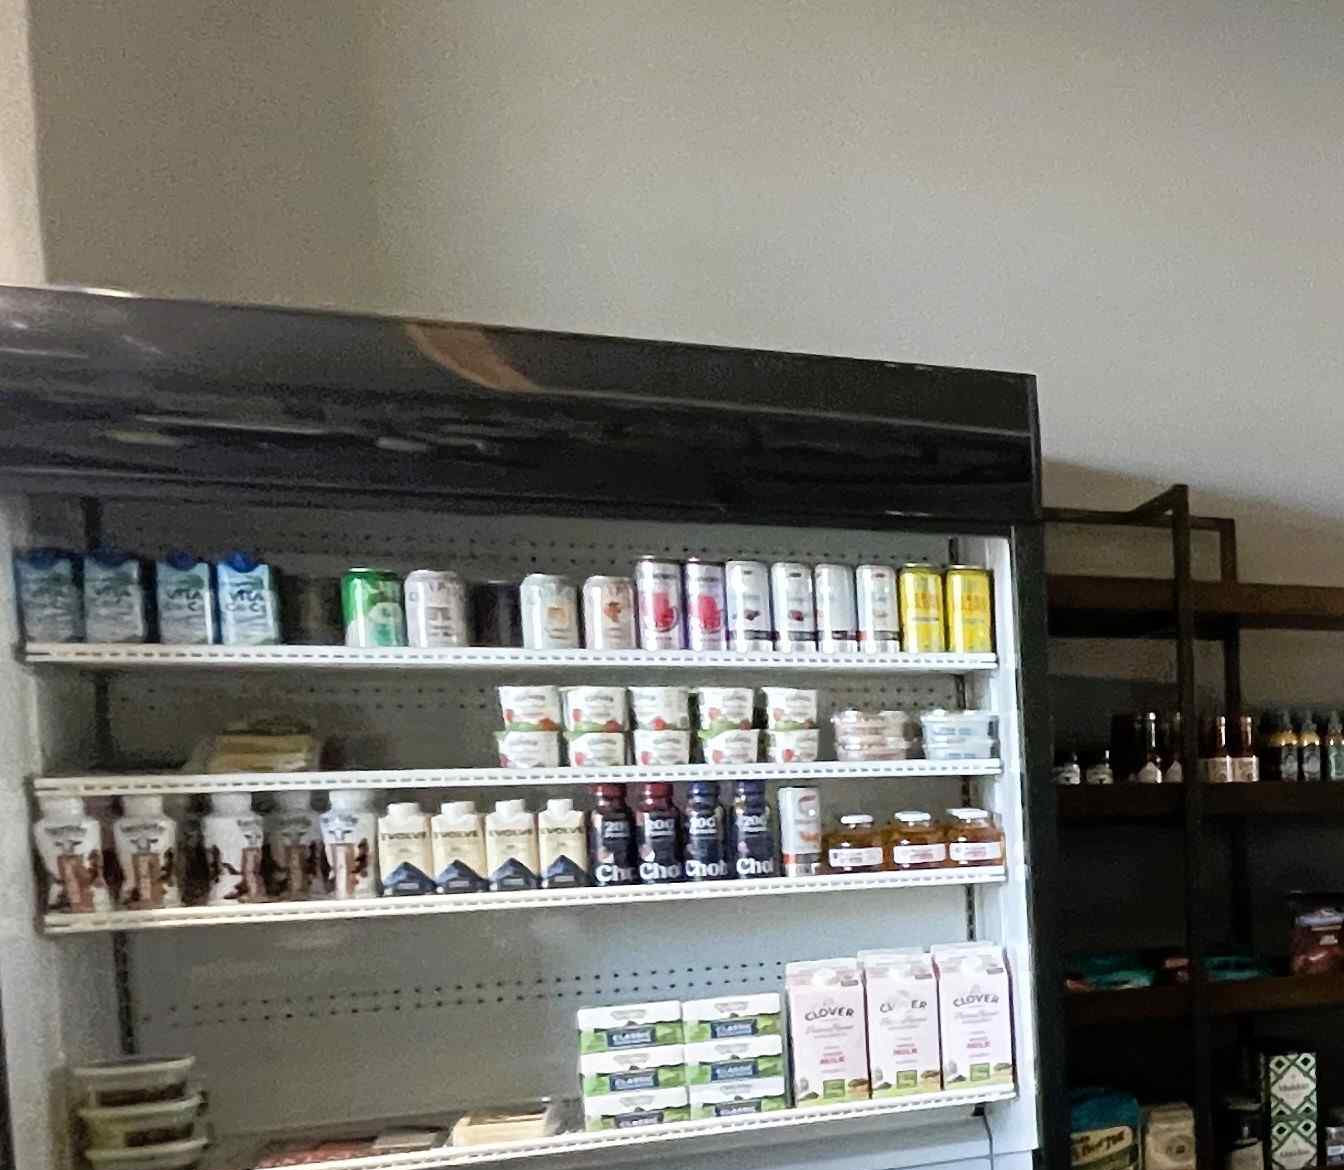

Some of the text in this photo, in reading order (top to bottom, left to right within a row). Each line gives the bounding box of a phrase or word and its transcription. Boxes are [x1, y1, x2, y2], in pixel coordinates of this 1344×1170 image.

[879, 999, 928, 1014] CLER
[952, 994, 1000, 1008] CLOVER
[804, 1006, 855, 1022] CLOVER
